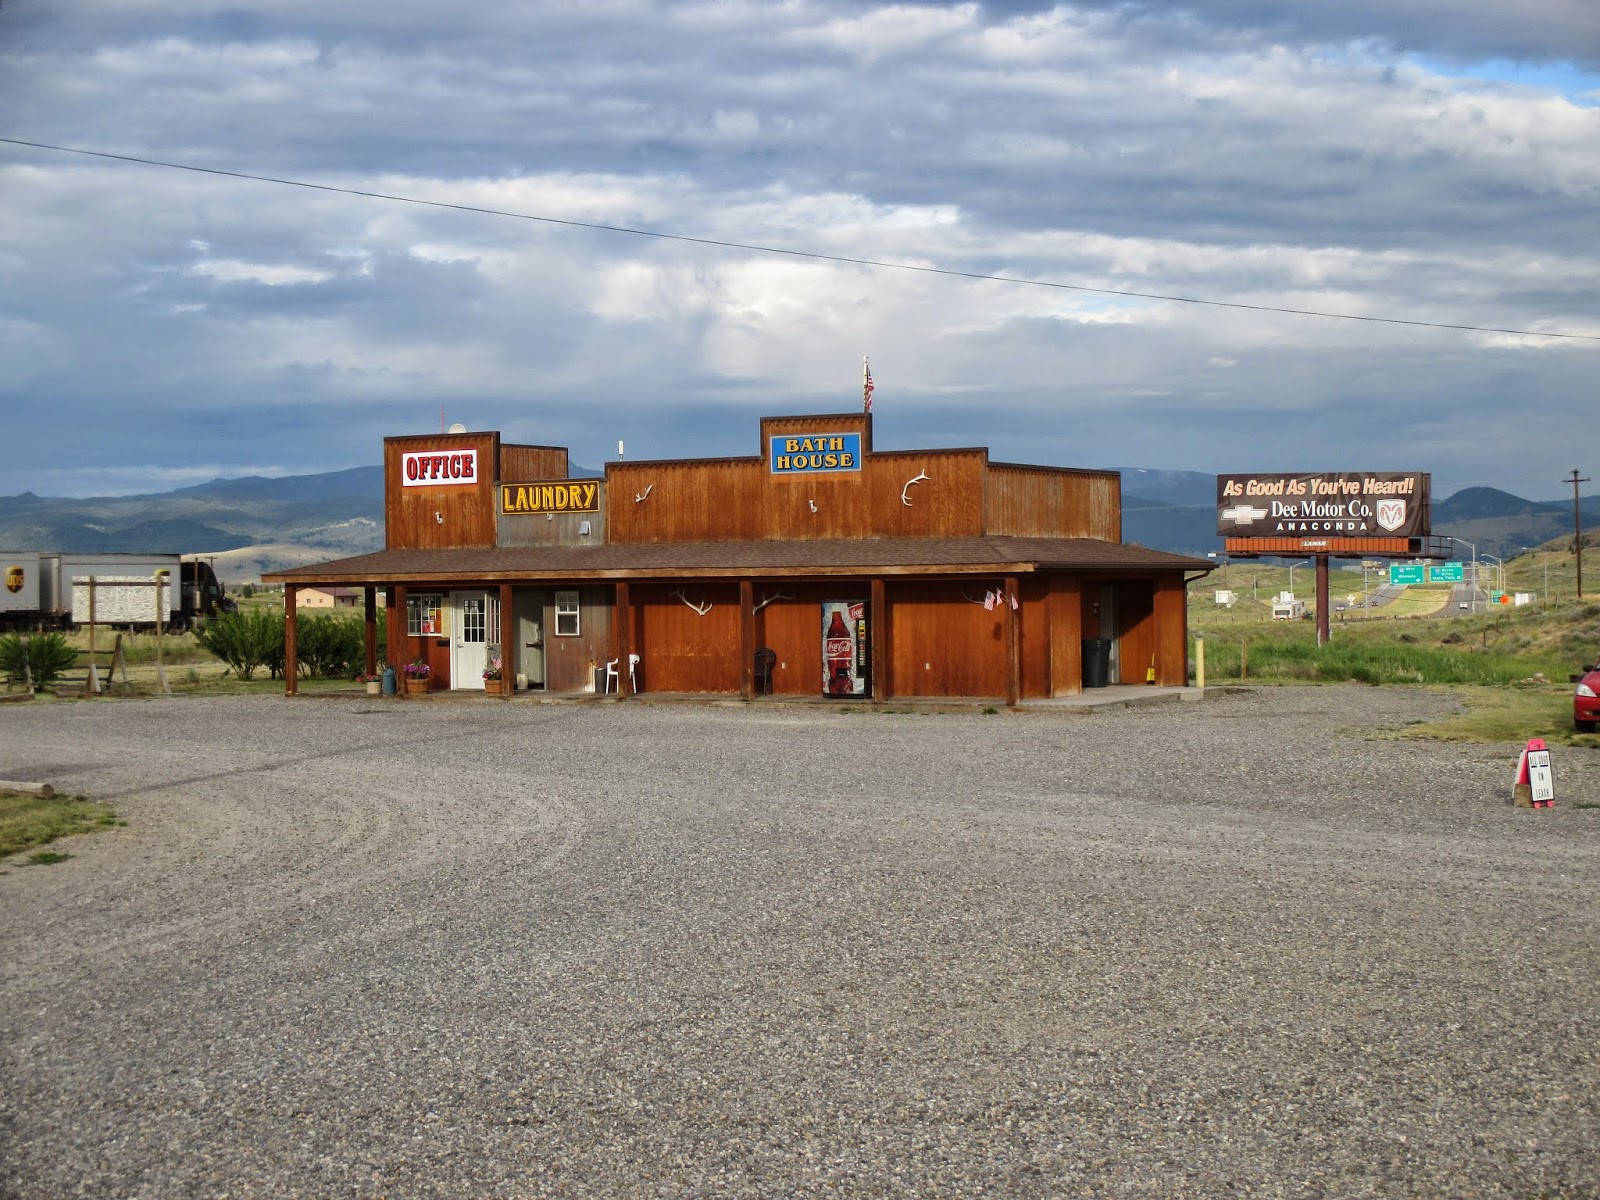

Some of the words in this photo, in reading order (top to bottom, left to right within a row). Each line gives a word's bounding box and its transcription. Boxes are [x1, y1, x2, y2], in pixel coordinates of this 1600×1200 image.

[786, 438, 844, 452] BATH
[406, 454, 473, 480] OFFICE
[777, 453, 853, 469] HOUSE
[1223, 480, 1244, 496] As
[1246, 480, 1285, 496] Good
[1286, 479, 1307, 495] As
[1310, 478, 1360, 495] You've
[1362, 478, 1414, 494] Heard!
[504, 484, 596, 511] LAUNDRY
[1271, 500, 1298, 517] Dee
[1300, 500, 1346, 517] Motor
[1348, 499, 1373, 517] Co.
[1276, 522, 1368, 531] ANACONDA
